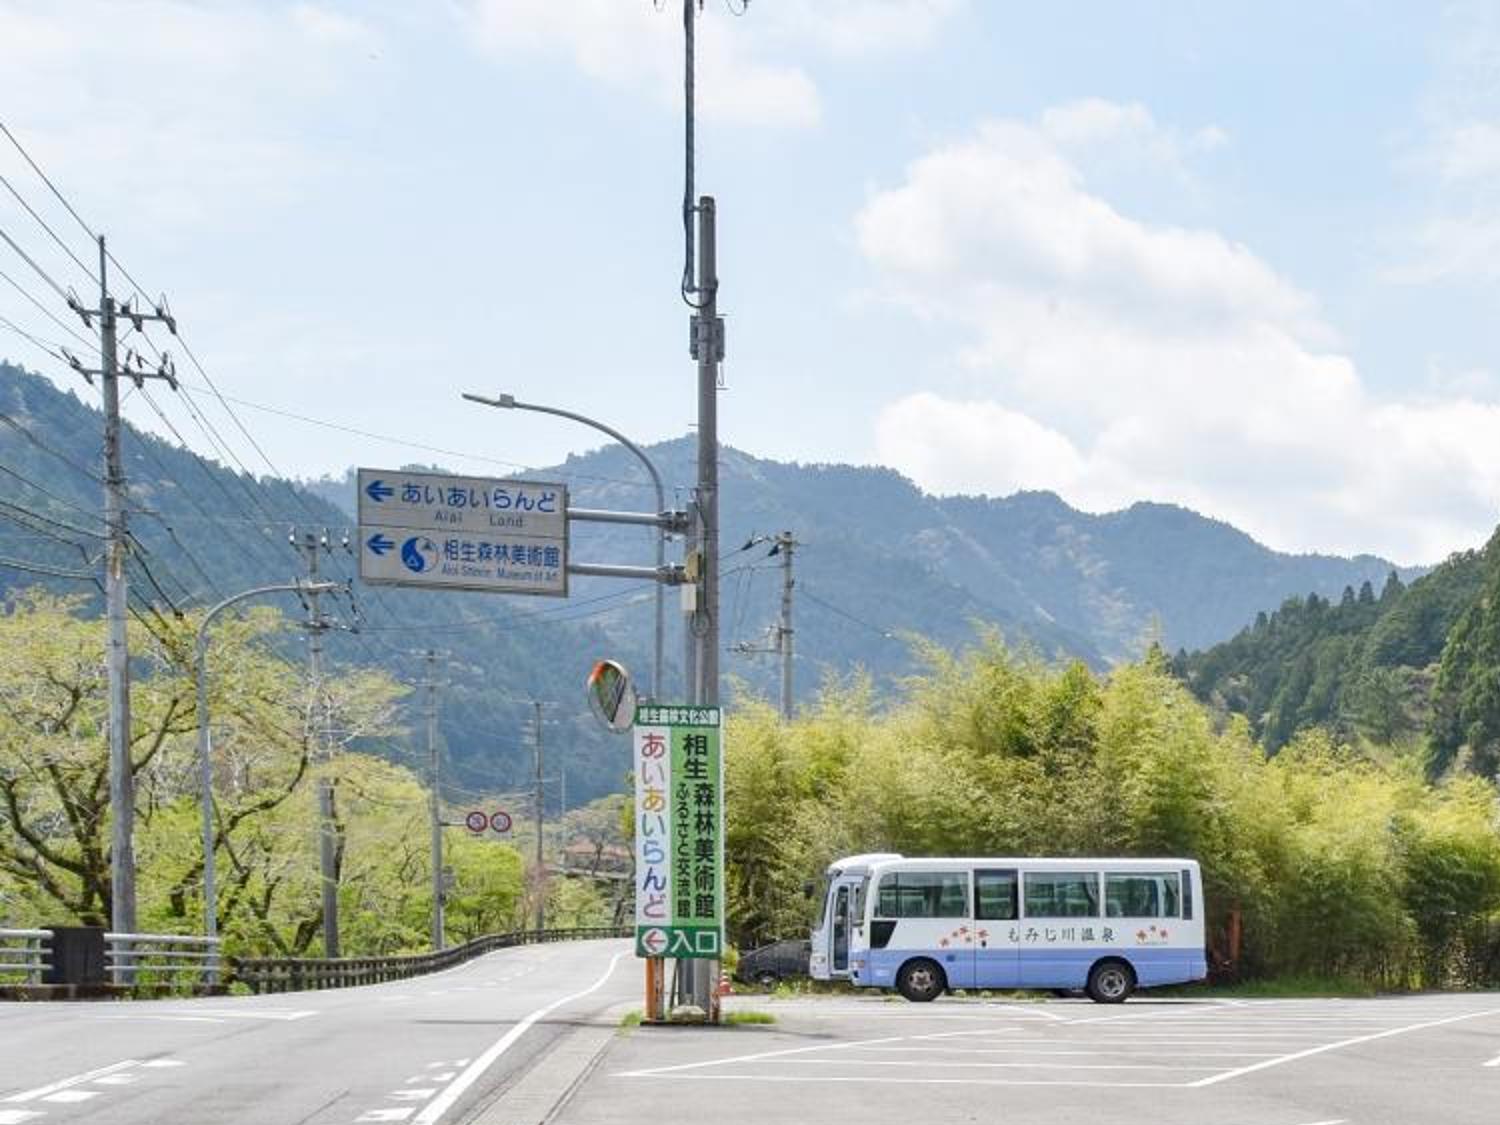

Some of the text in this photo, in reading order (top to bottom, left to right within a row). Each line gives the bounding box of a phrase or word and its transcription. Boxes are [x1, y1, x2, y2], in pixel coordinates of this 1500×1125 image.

[402, 483, 555, 513] あいあいらんど
[489, 516, 523, 528] Land
[443, 540, 559, 568] 相生森林美術館
[641, 732, 666, 918] あいあいらんど
[675, 782, 690, 918] ふるさと交流館
[670, 931, 717, 952] 入口
[1008, 927, 1114, 943] もみじ川温泉
